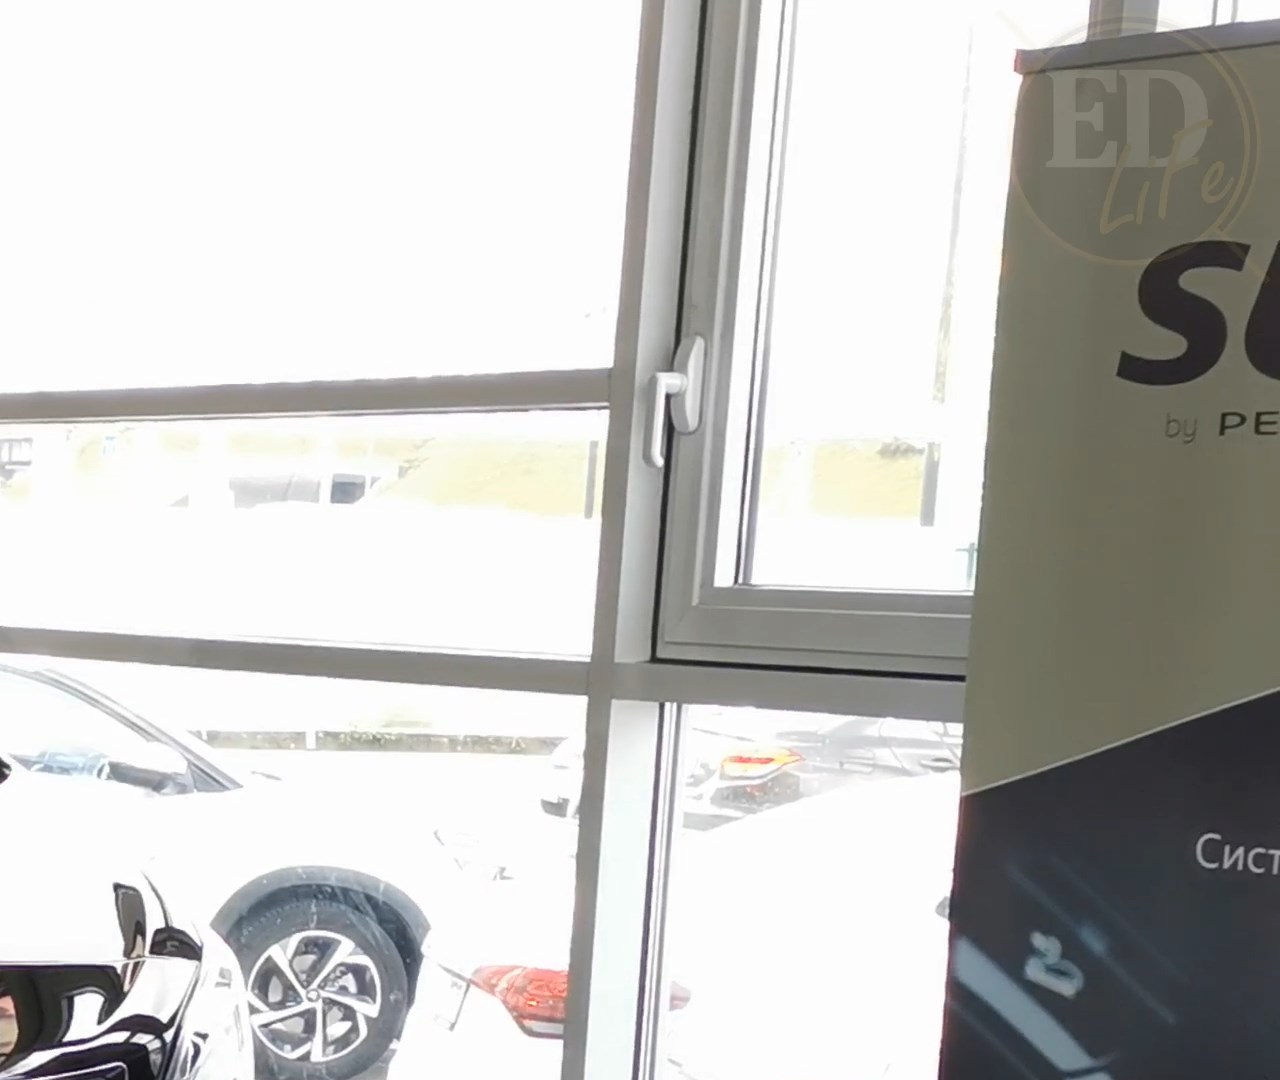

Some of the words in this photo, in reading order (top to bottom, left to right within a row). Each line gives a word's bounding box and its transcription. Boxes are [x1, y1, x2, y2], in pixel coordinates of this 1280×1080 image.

[1164, 412, 1198, 444] by
[1218, 411, 1280, 437] PE
[1195, 832, 1280, 875] Сист
